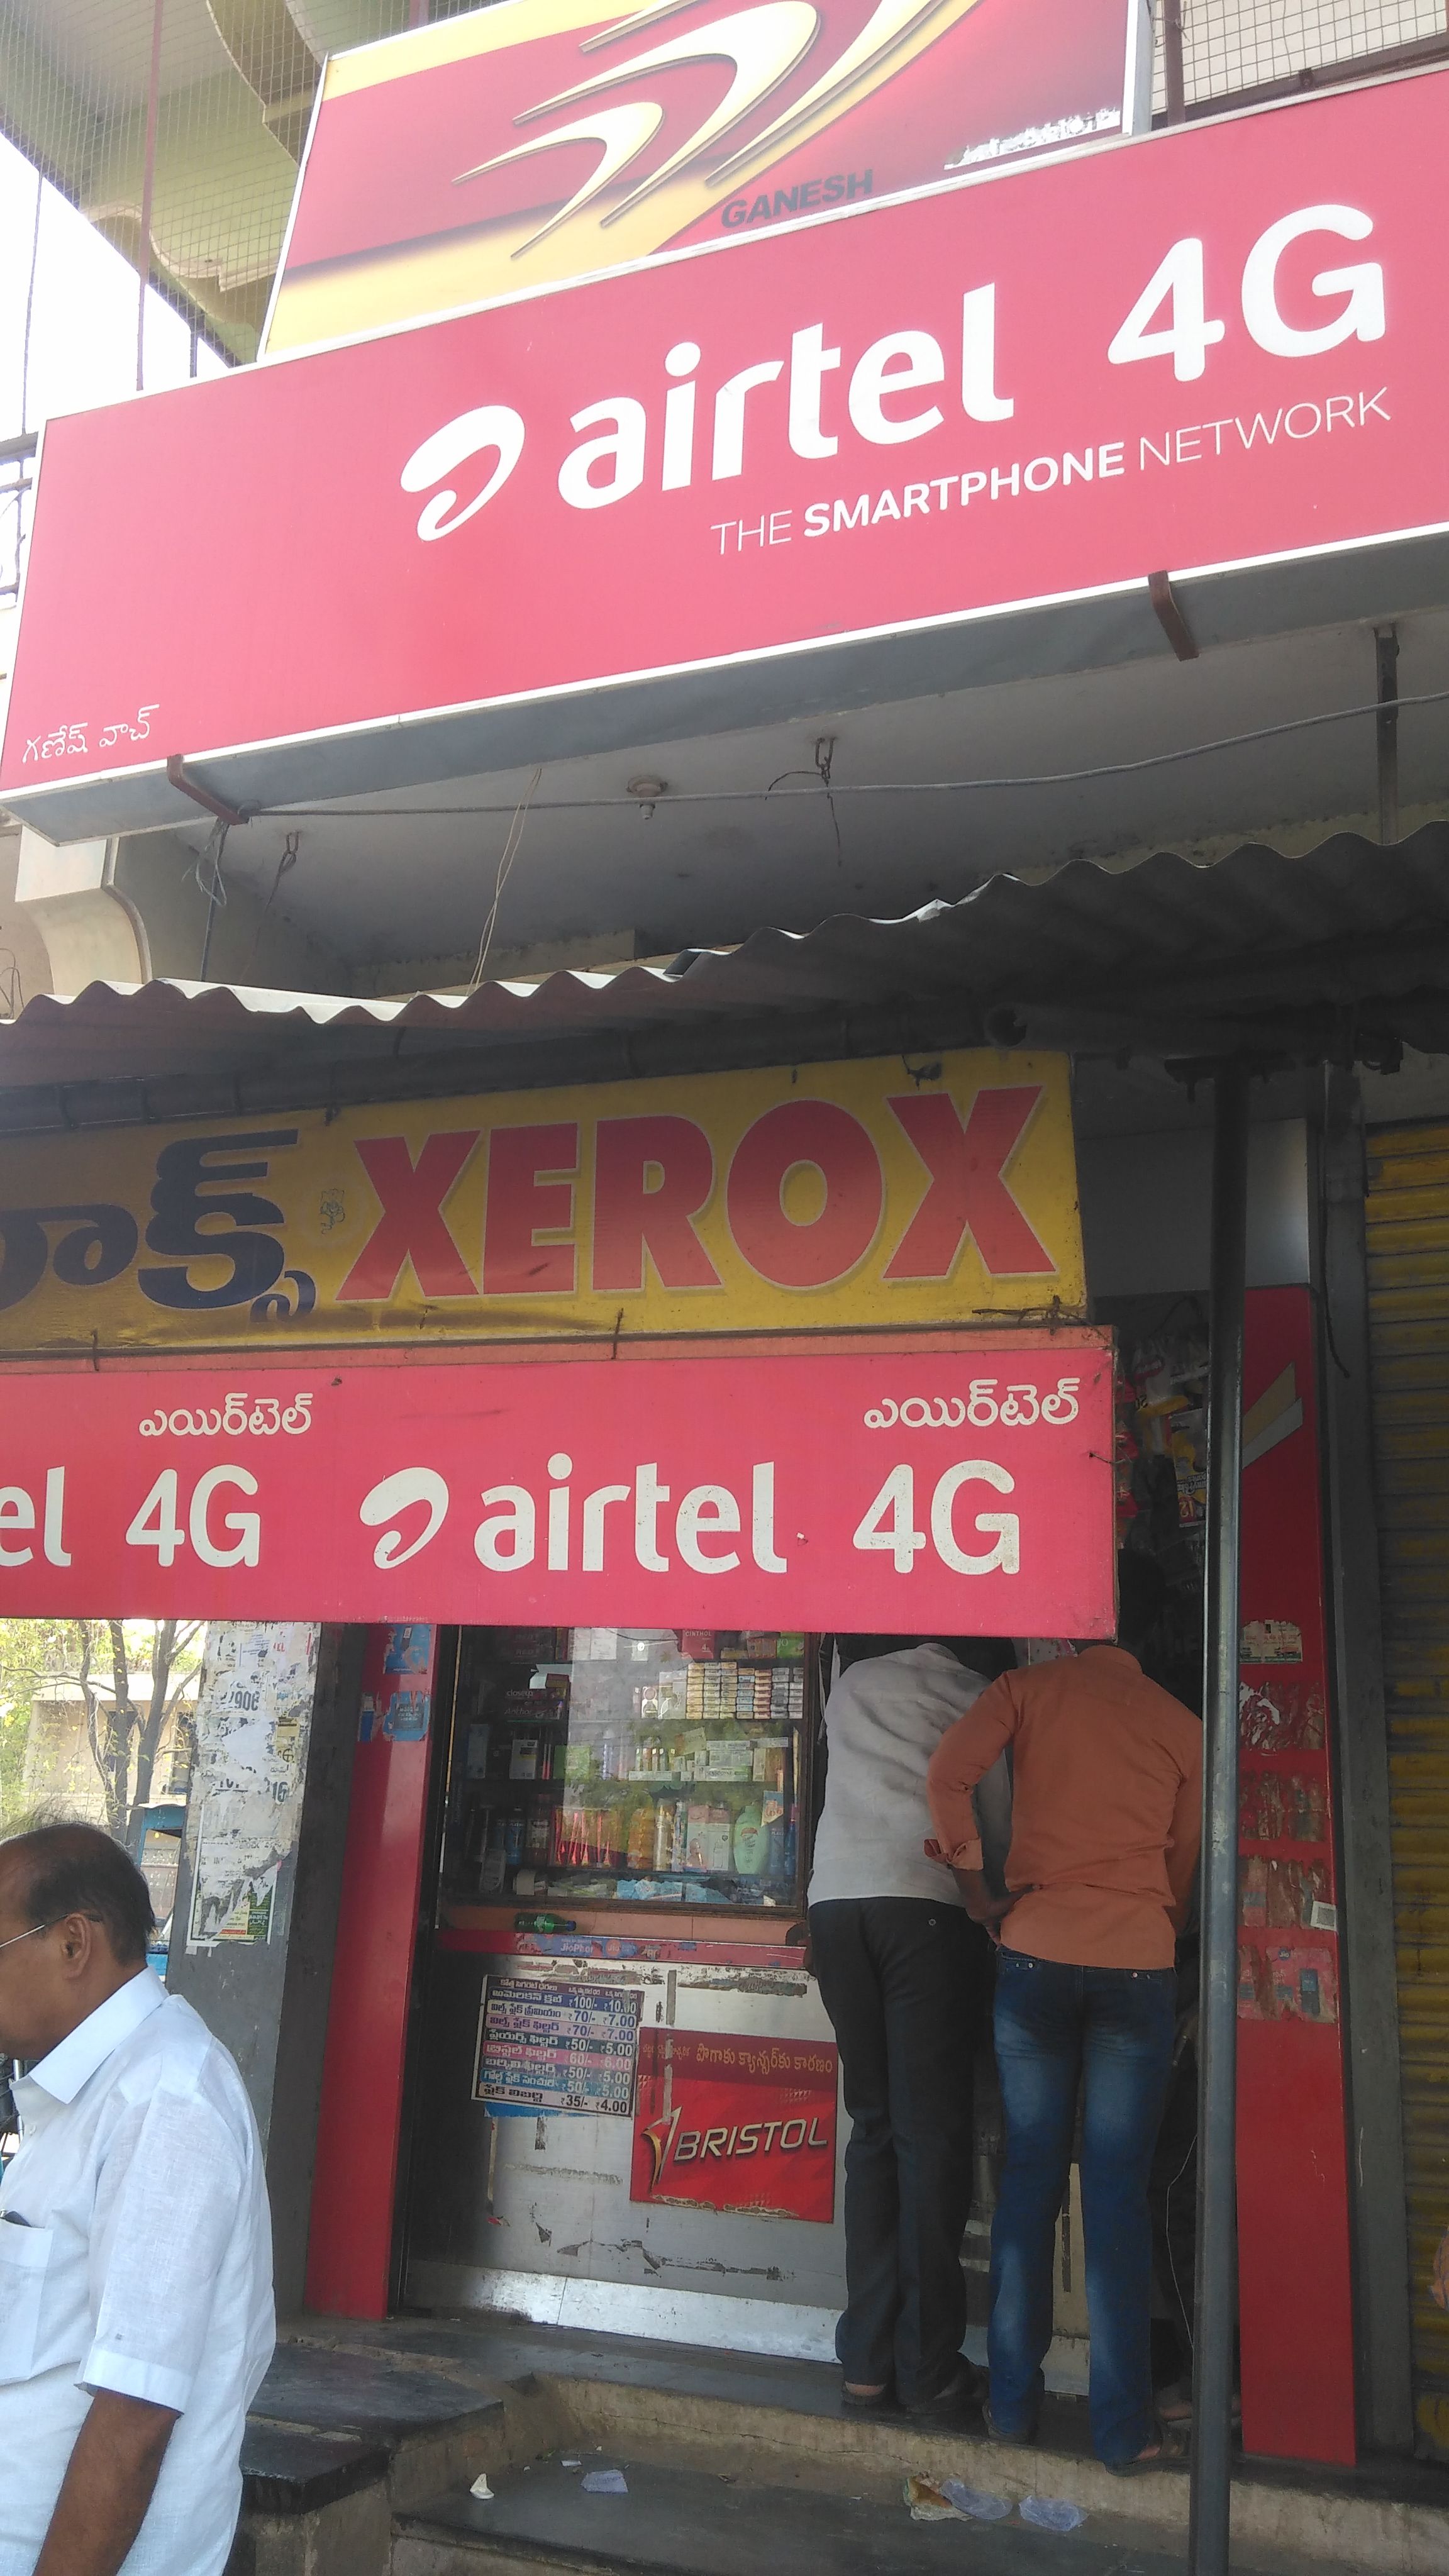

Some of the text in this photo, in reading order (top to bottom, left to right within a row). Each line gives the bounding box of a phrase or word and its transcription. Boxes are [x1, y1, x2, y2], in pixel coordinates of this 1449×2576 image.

[721, 169, 874, 228] GANESH
[557, 204, 1386, 509] airtel 4G
[711, 387, 1392, 555] THE SMARTPHONE NETWORK
[99, 704, 160, 747] వాచ్
[335, 1084, 1058, 1302] XEROX
[125, 1464, 261, 1568] 4G
[474, 1453, 1019, 1575] airtel 4G
[672, 2117, 828, 2162] BRISTOL
